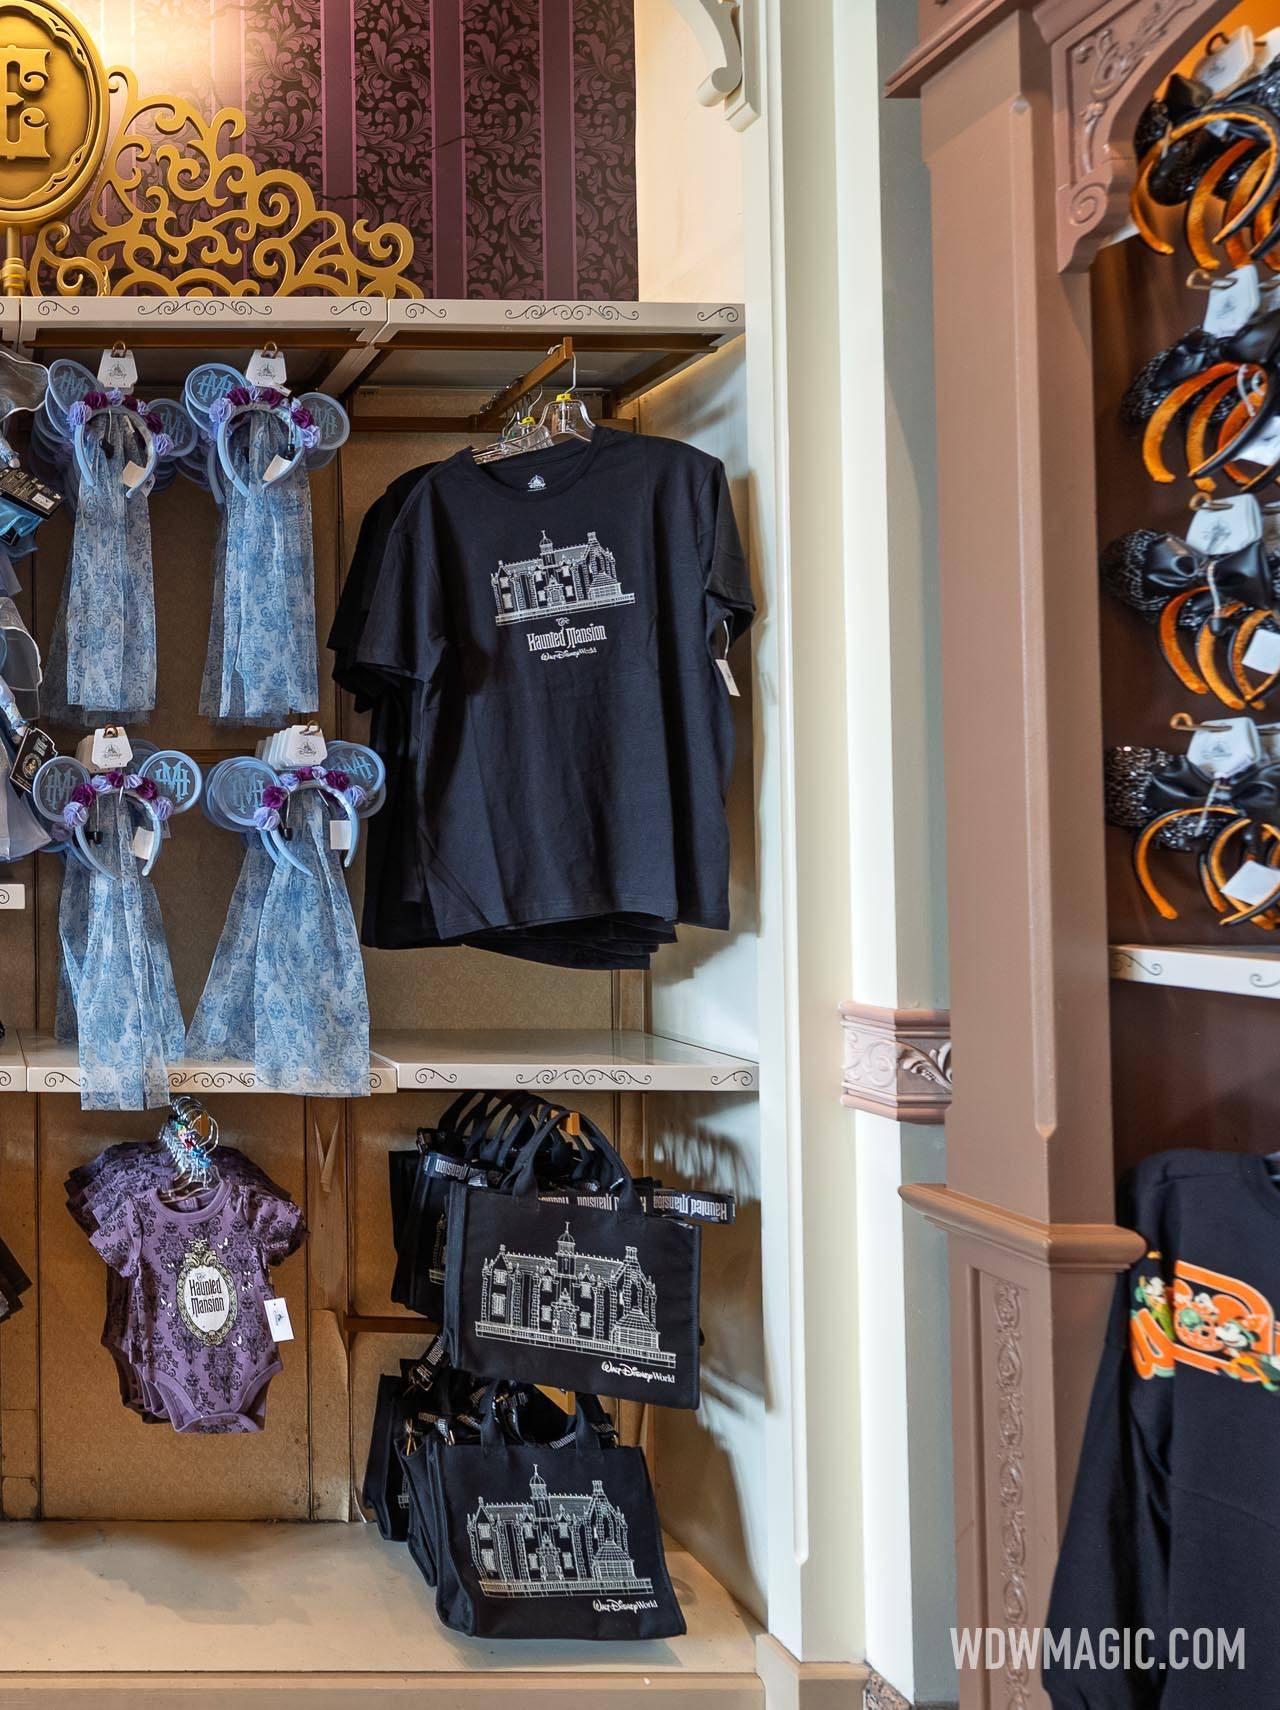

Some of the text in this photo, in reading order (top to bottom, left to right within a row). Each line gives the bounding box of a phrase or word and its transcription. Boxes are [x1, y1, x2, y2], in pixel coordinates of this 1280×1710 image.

[526, 623, 607, 651] Haunted Mansion
[653, 1193, 692, 1216] Mansion
[690, 1198, 727, 1221] Haunted
[189, 1278, 222, 1297] Haunted
[191, 1296, 225, 1318] Mansion
[601, 1361, 675, 1383] Walt Disney World
[593, 1599, 658, 1614] Walt Disney World
